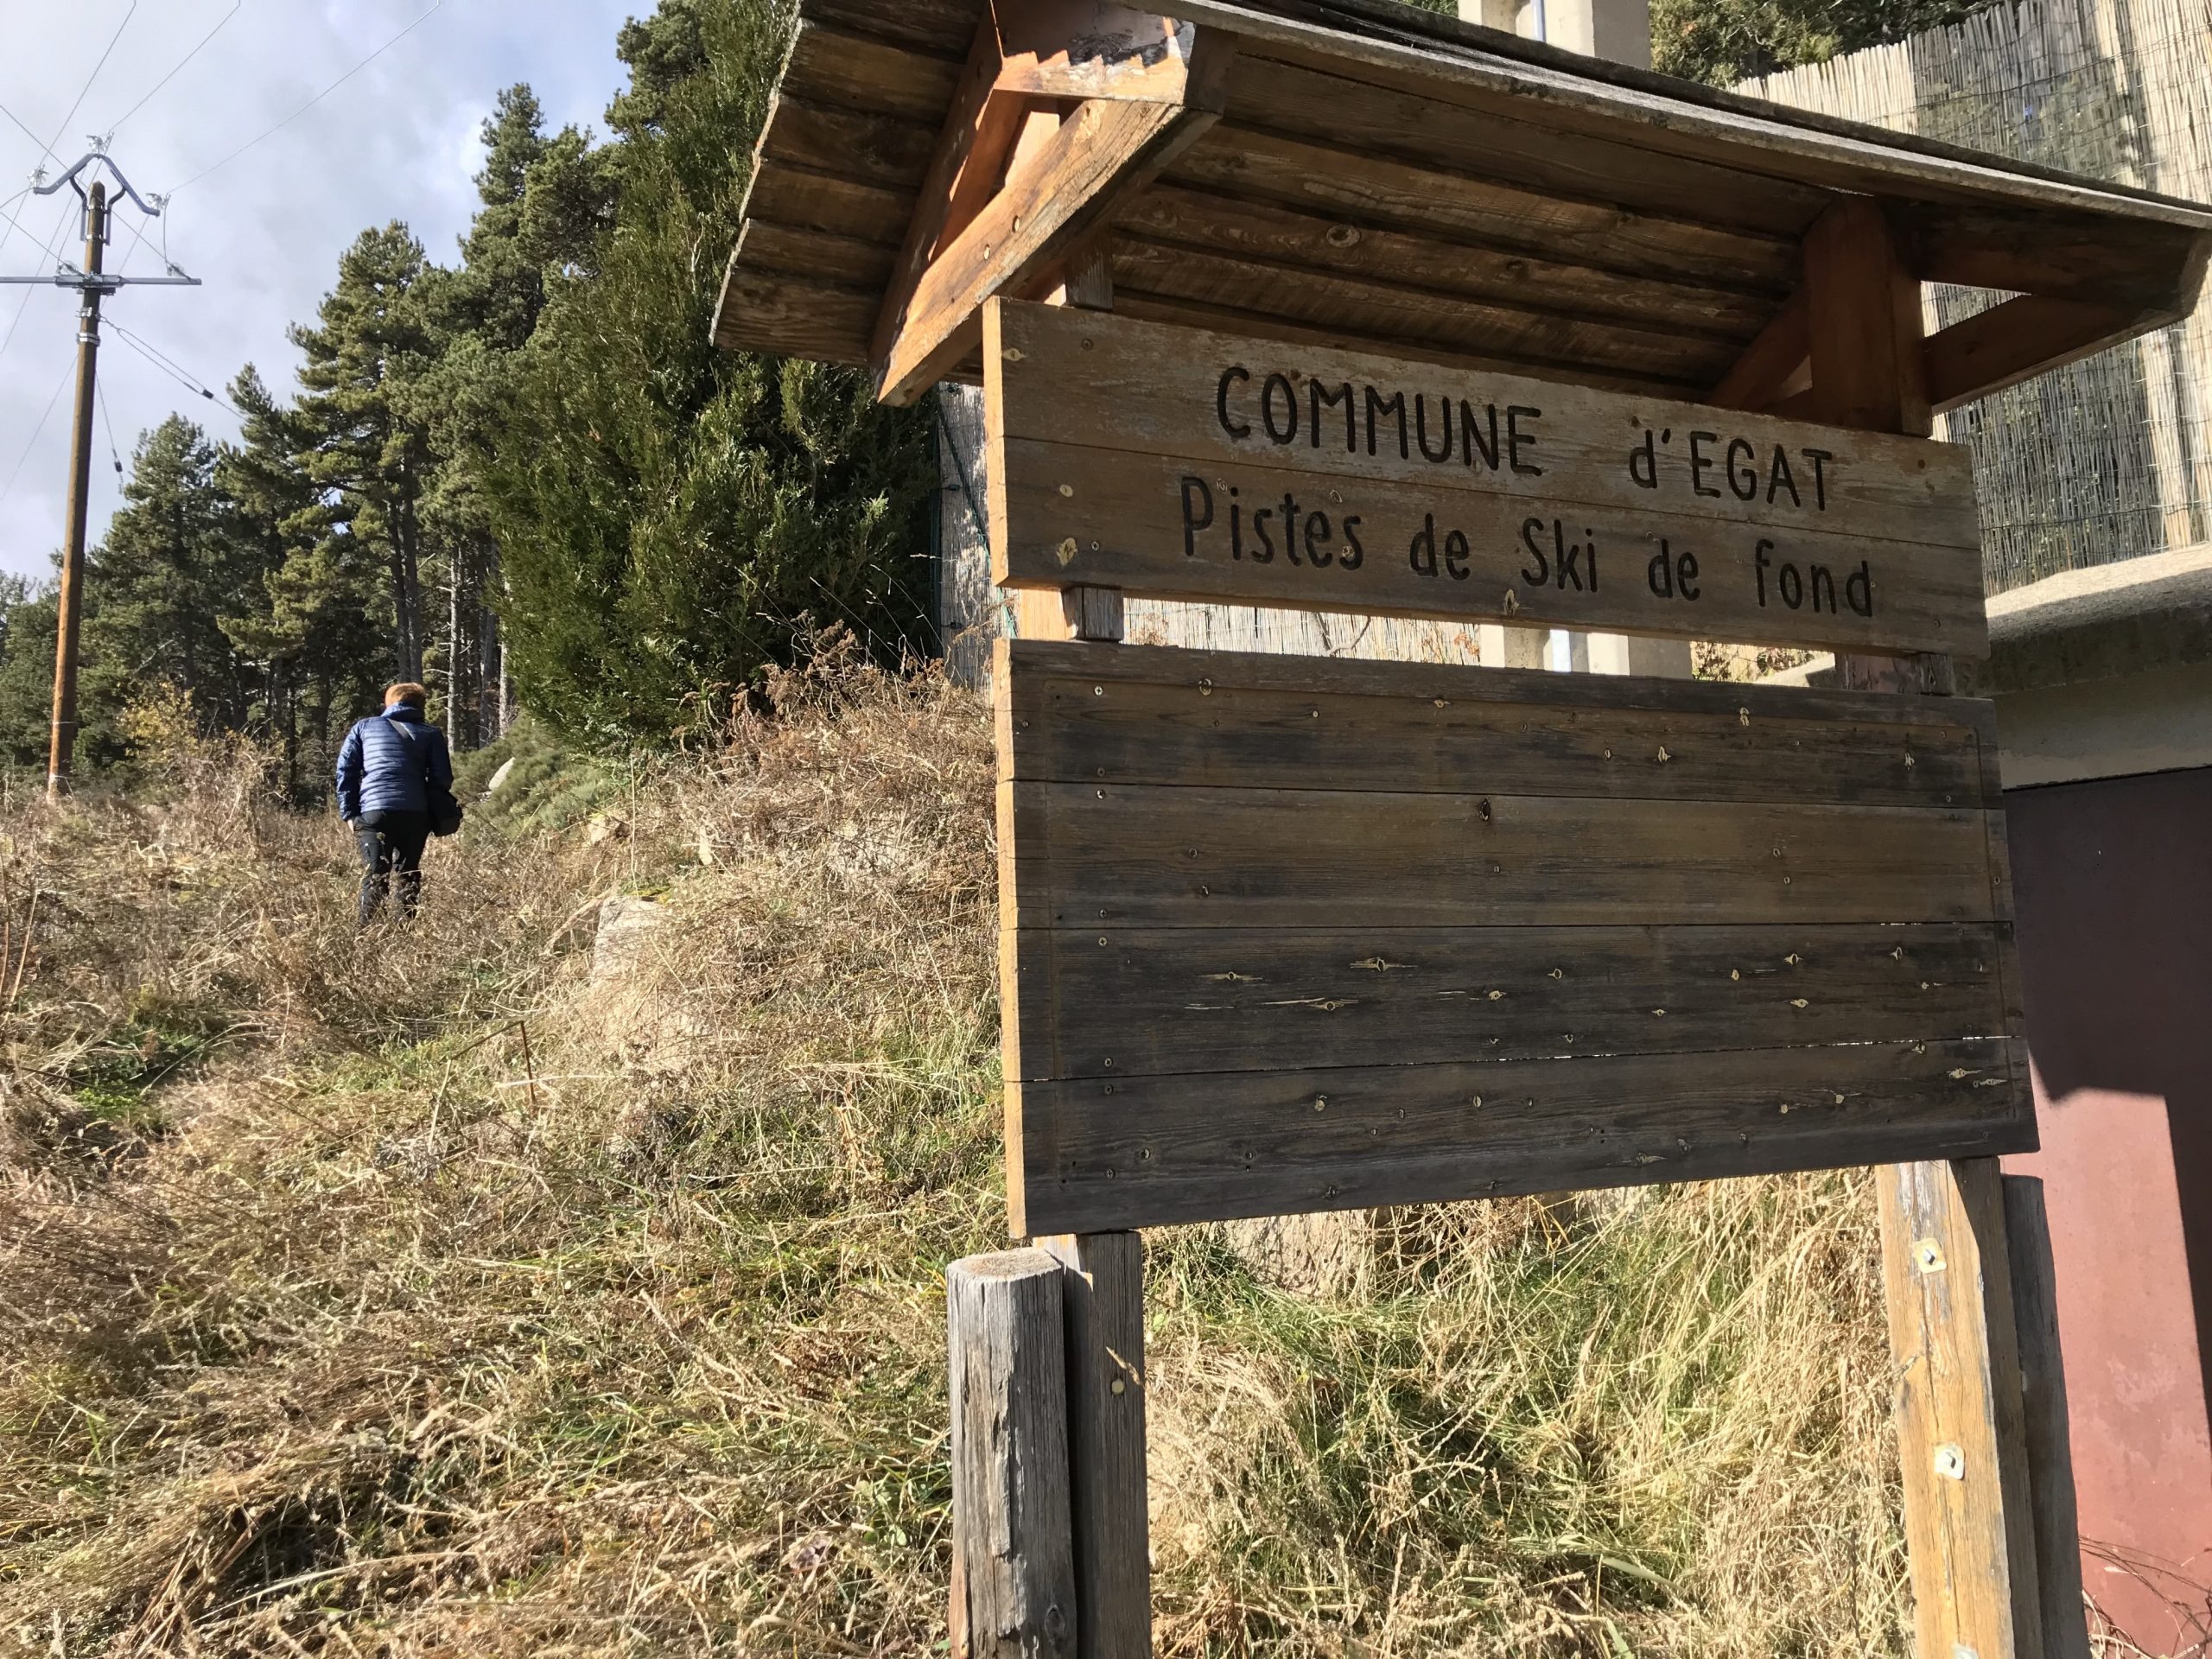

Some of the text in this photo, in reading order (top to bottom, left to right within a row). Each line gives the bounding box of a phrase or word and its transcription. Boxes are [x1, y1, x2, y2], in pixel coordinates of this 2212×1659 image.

[1217, 366, 1833, 511] COMMUNE d'EGAT
[1180, 476, 1873, 618] Pistes de Ski de fond
